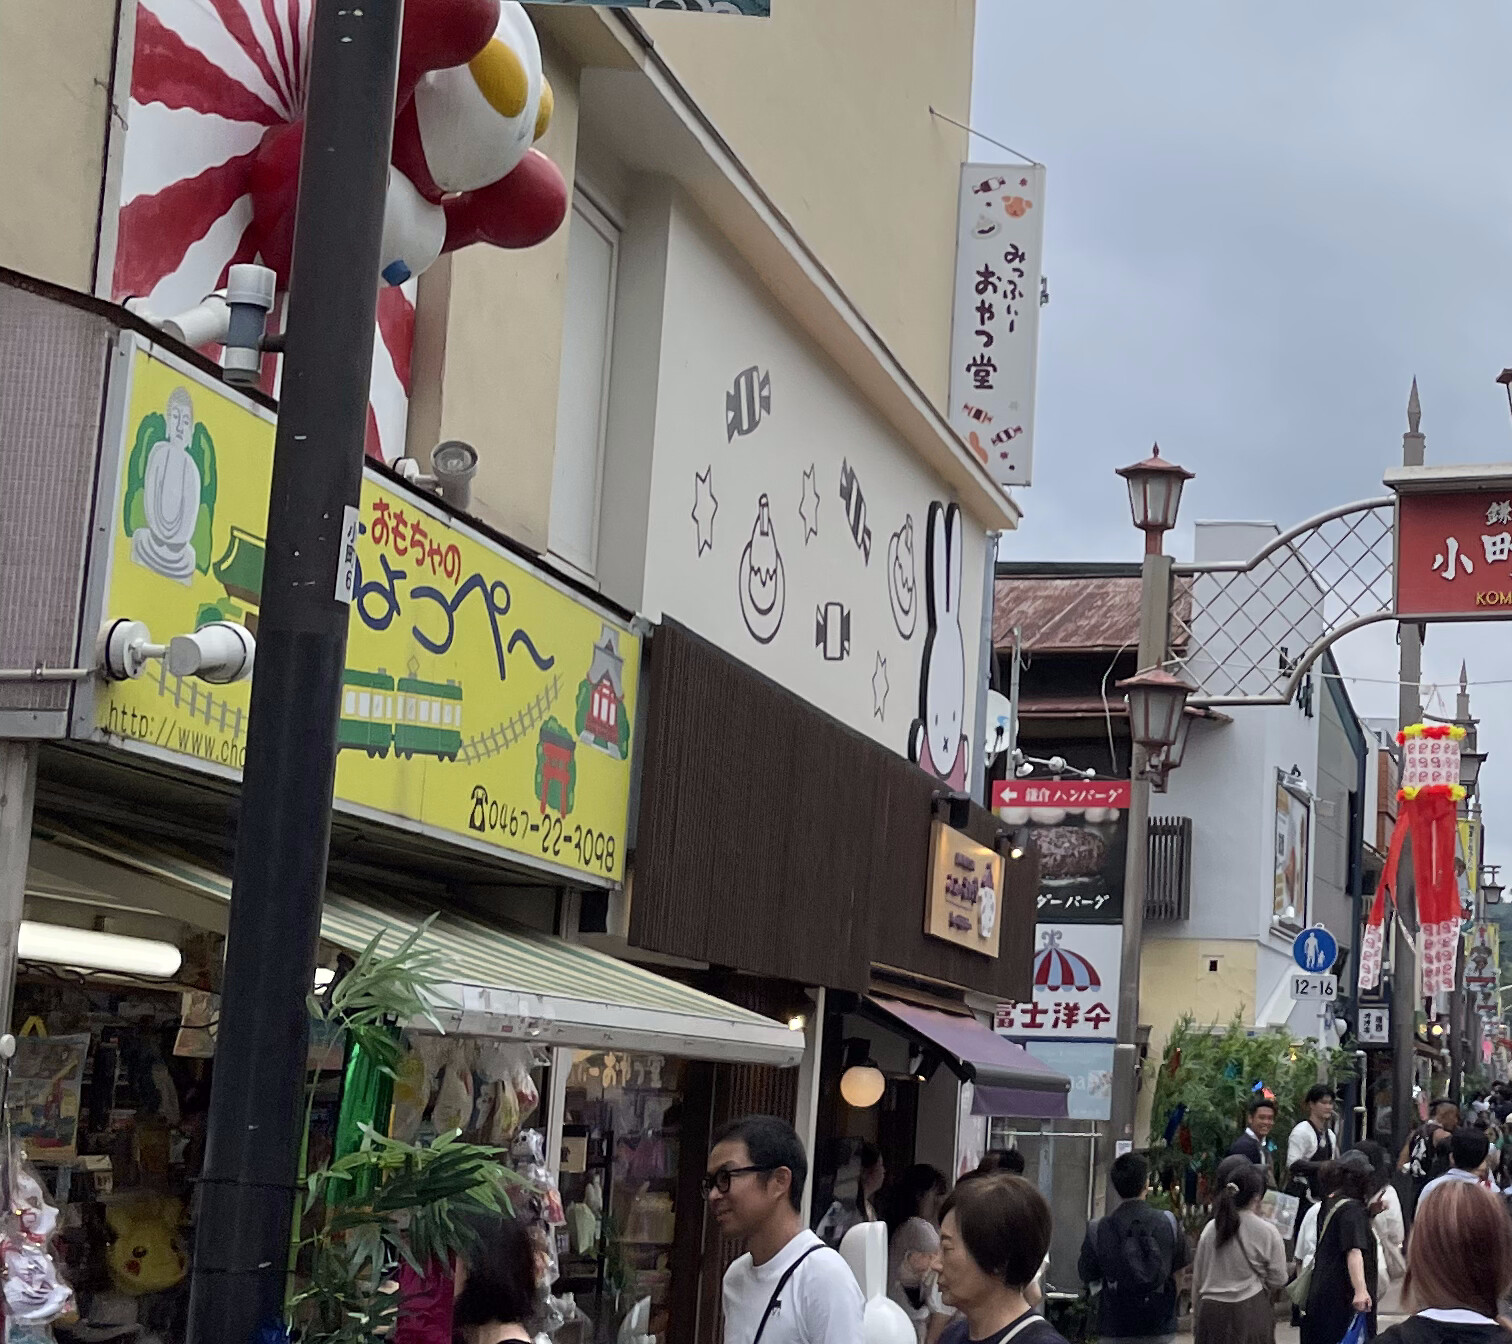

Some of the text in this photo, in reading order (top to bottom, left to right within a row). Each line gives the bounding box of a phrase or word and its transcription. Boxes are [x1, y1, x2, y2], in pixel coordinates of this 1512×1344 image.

[965, 262, 1003, 391] おやつ堂
[1003, 242, 1027, 334] みっふぃー
[371, 497, 461, 587] おもちゃの
[488, 799, 616, 873] 0467-22-3098
[1294, 979, 1335, 997] 12-16
